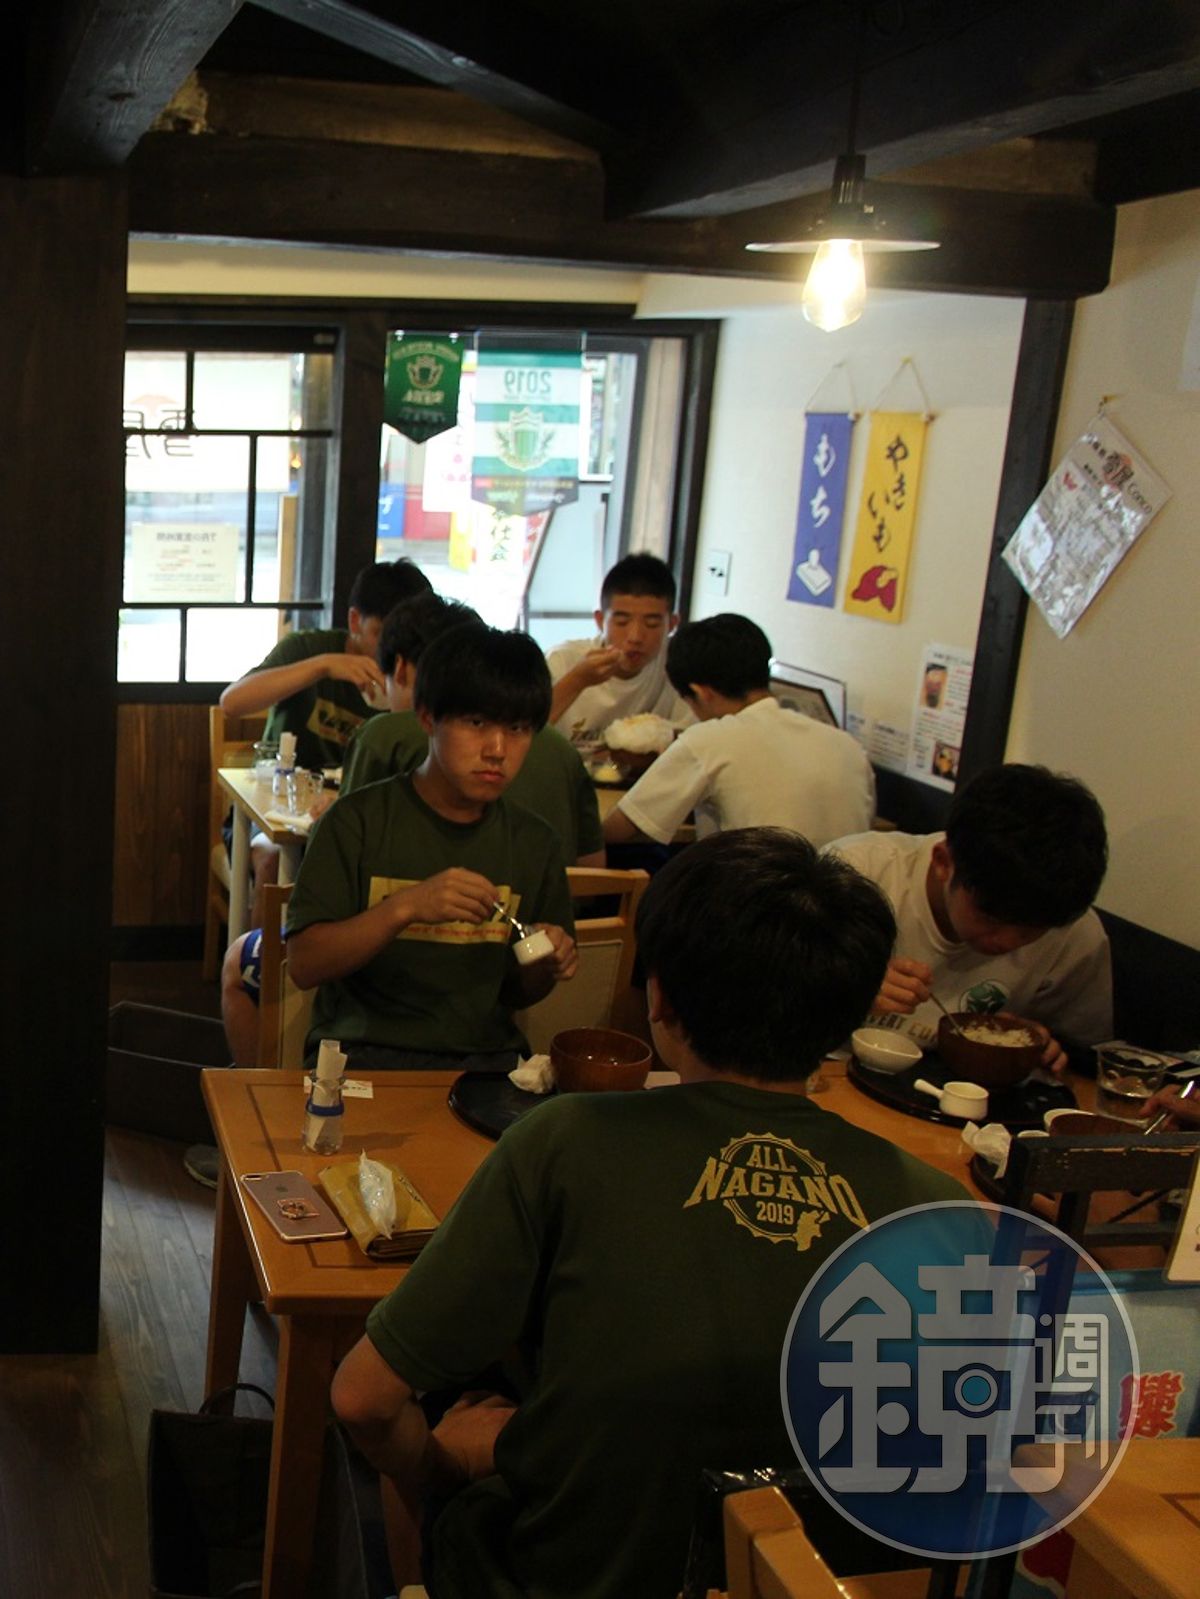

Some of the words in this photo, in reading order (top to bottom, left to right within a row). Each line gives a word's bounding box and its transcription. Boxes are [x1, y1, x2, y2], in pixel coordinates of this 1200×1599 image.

[810, 433, 836, 528] もち
[746, 1144, 798, 1173] ALL
[682, 1156, 871, 1233] NAGANO
[755, 1201, 795, 1226] 2019
